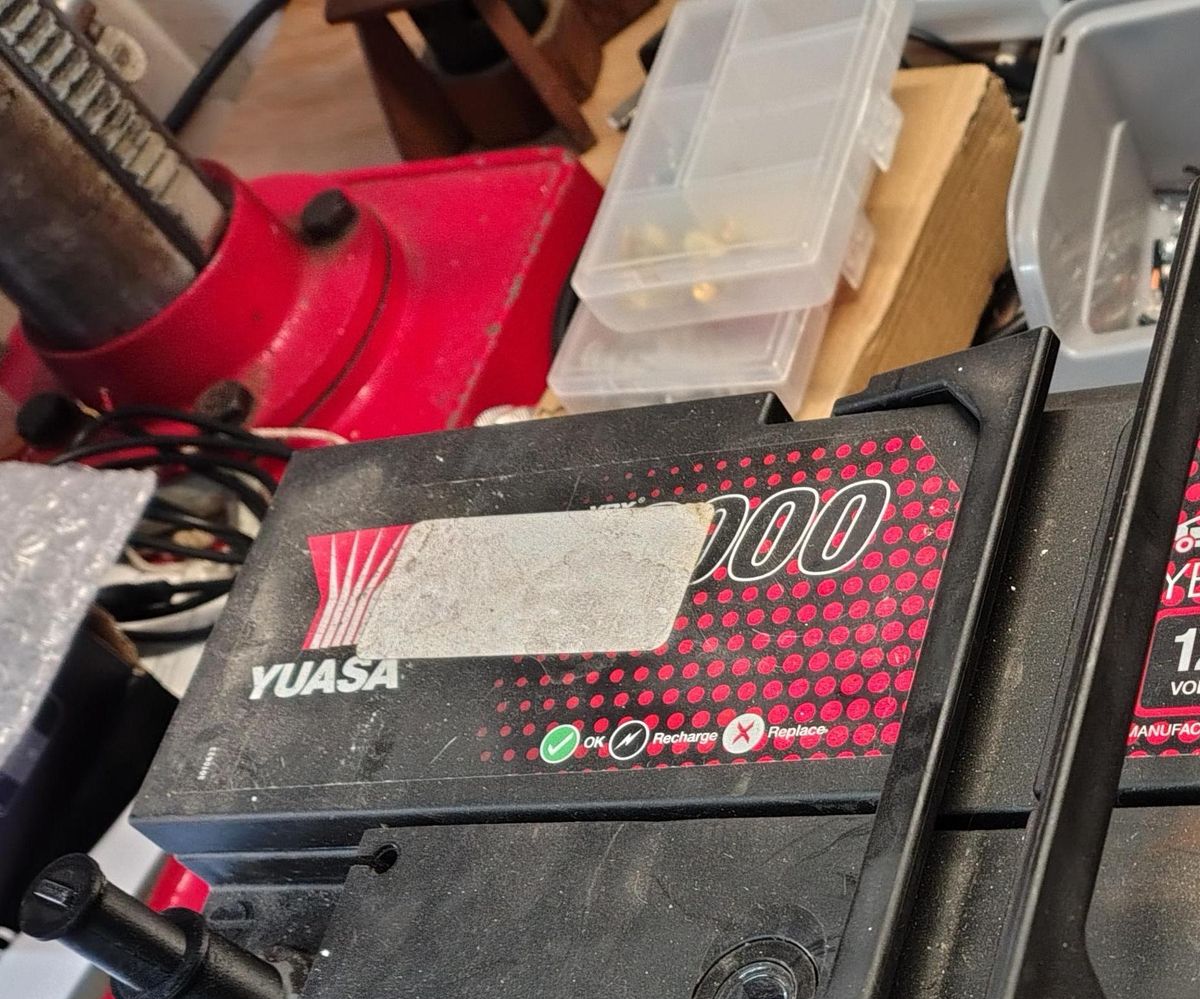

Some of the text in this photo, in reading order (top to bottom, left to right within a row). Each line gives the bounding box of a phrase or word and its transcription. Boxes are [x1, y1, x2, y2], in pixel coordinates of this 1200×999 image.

[249, 656, 399, 700] YUASA
[653, 730, 719, 748] Recharge
[767, 725, 827, 742] Replace
[584, 735, 606, 750] OK
